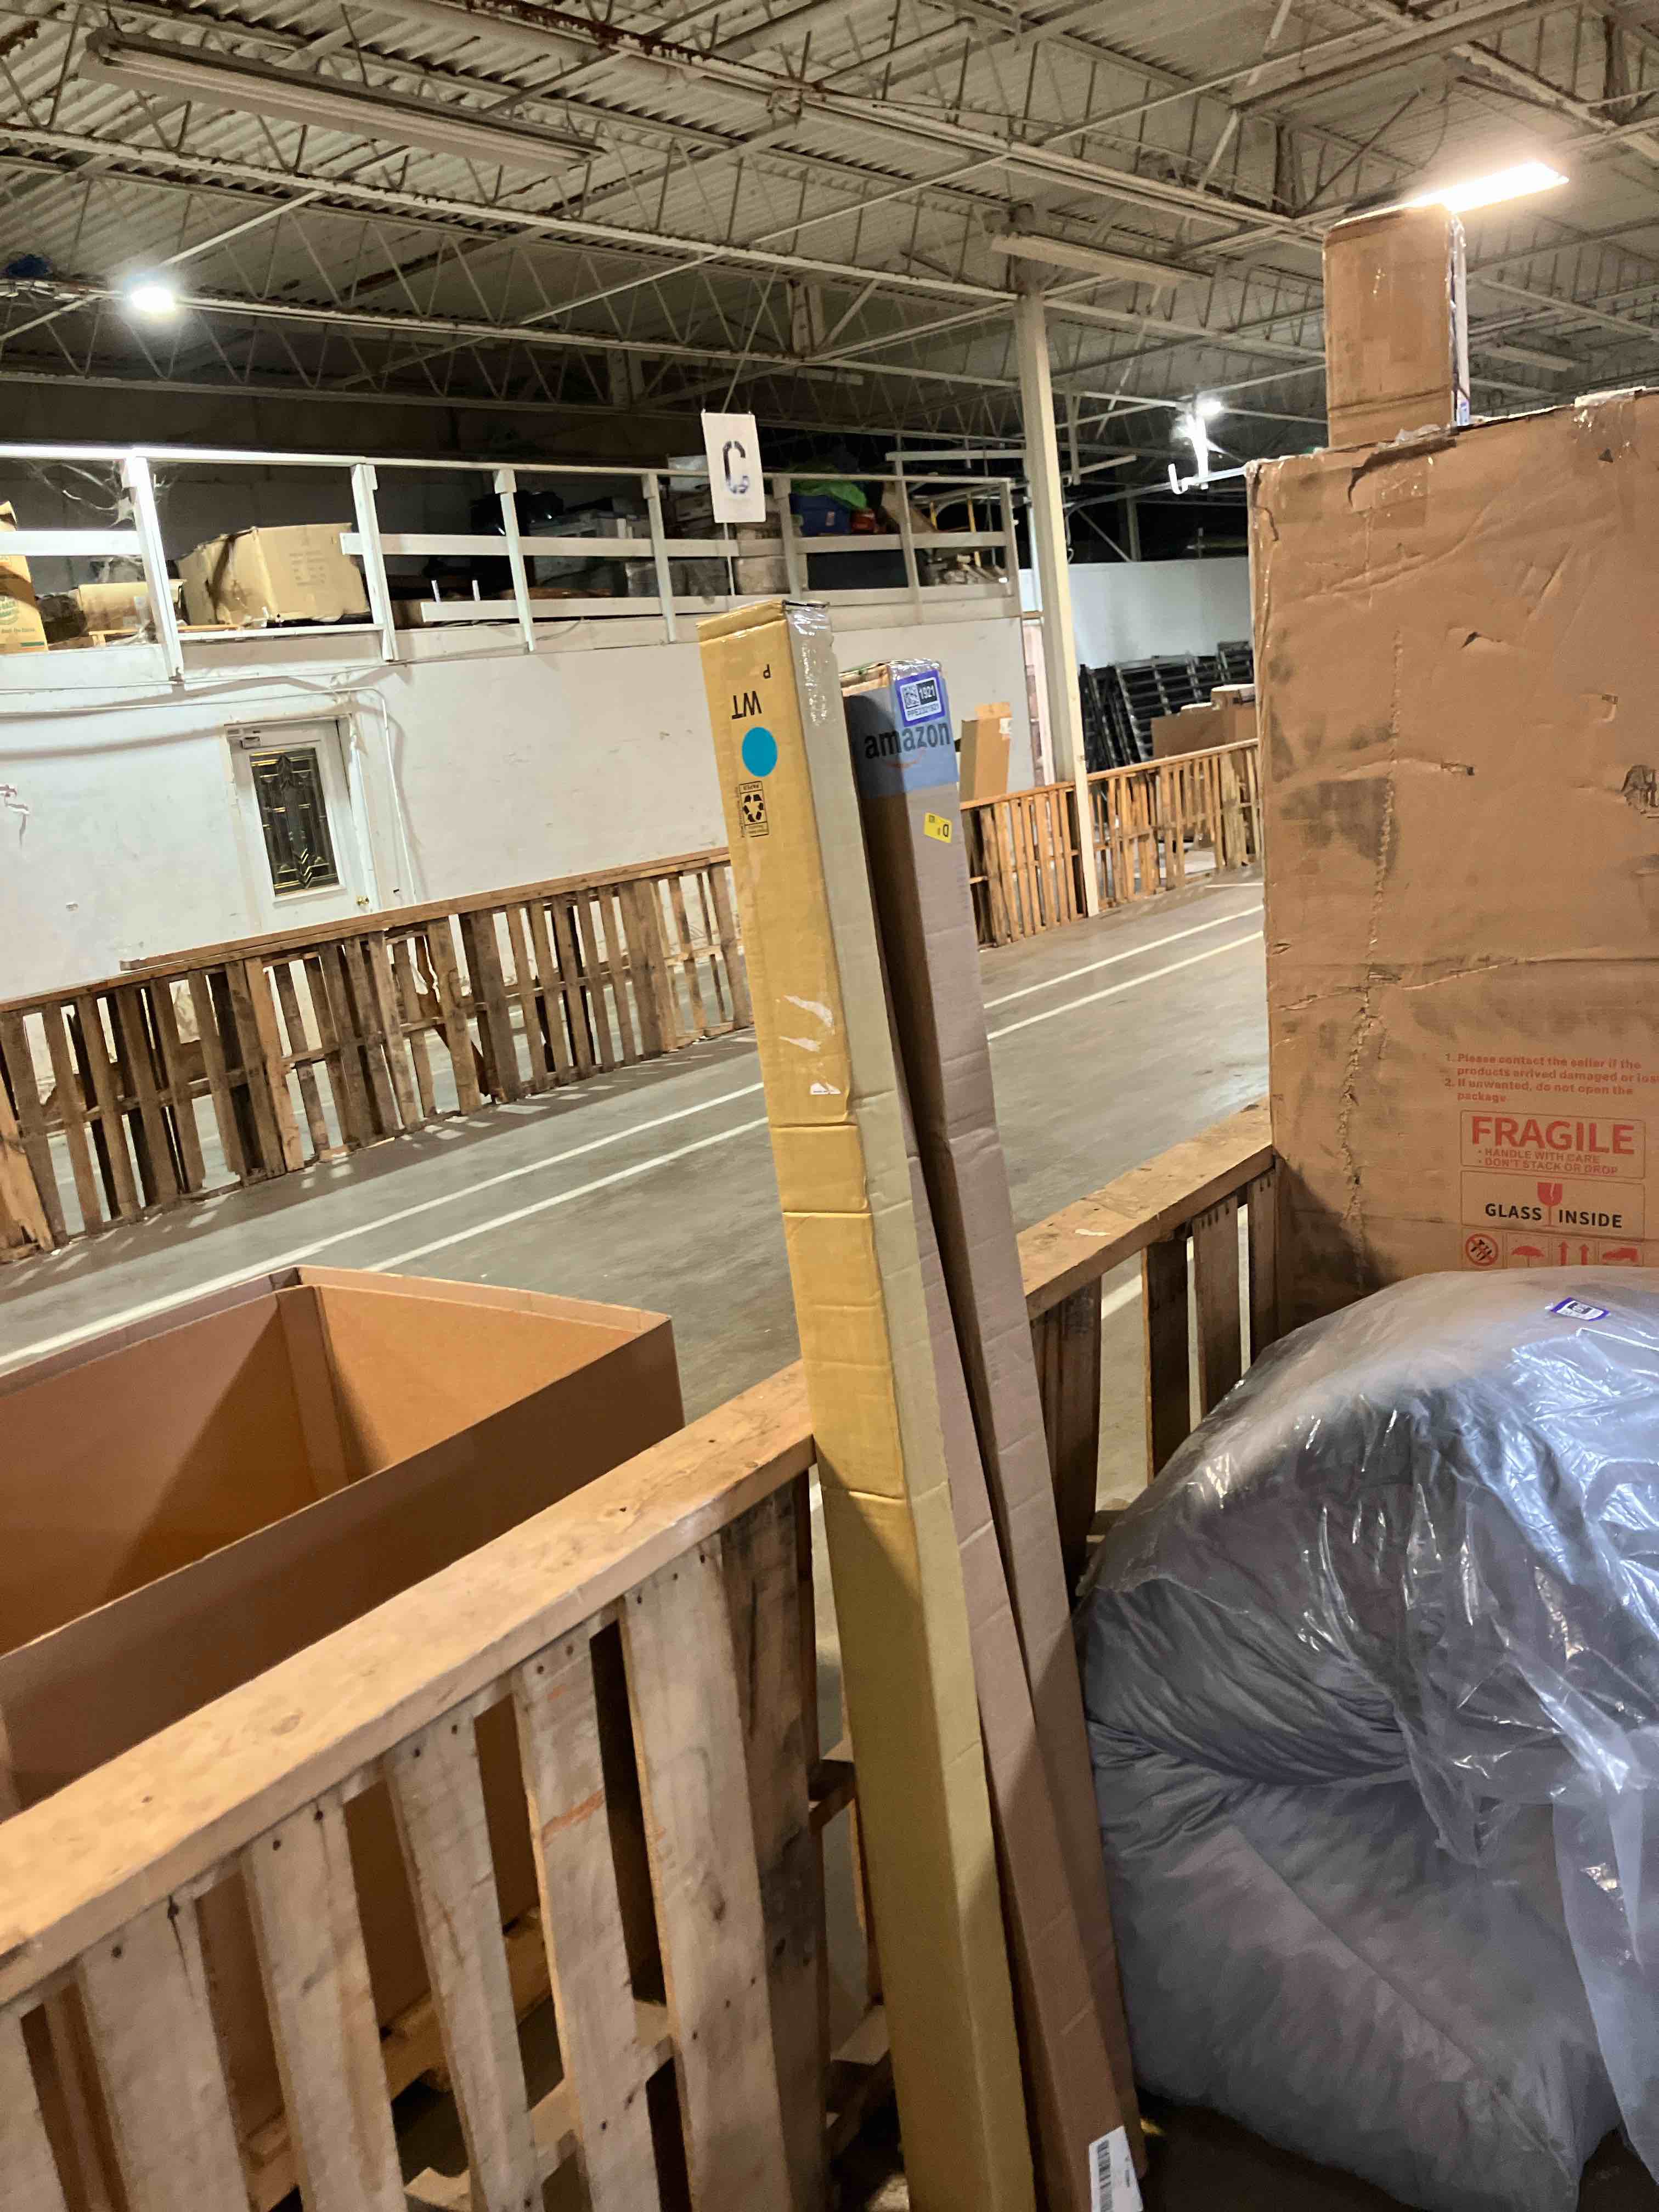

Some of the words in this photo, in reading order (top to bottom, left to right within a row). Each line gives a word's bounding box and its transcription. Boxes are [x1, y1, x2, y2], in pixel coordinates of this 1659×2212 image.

[731, 691, 763, 720] WT
[865, 723, 951, 759] amazon
[1444, 1053, 1453, 1062] 1.
[1458, 1053, 1496, 1063] Please
[1499, 1056, 1544, 1065] contact
[1548, 1057, 1567, 1066] the
[1571, 1058, 1605, 1067] seller
[1609, 1058, 1617, 1068] if
[1621, 1059, 1642, 1069] the
[1457, 1068, 1510, 1077] products
[1514, 1069, 1556, 1079] arrived
[1559, 1070, 1617, 1082] damaged
[1457, 1092, 1506, 1103] package
[1536, 1083, 1550, 1091] do
[1554, 1084, 1575, 1093] not
[1578, 1086, 1609, 1096] open
[1613, 1085, 1634, 1095] the
[1472, 1116, 1634, 1155] FRAGILE
[1485, 1148, 1532, 1159] HANDLE
[1535, 1151, 1564, 1161] WITH
[1567, 1154, 1601, 1164] CARE
[1485, 1158, 1520, 1167] DON'T
[1522, 1159, 1560, 1171] STACK
[1565, 1163, 1581, 1172] OR
[1584, 1164, 1618, 1174] DROP
[1485, 1203, 1542, 1221] GLASS
[1559, 1209, 1623, 1228] INSIDE
